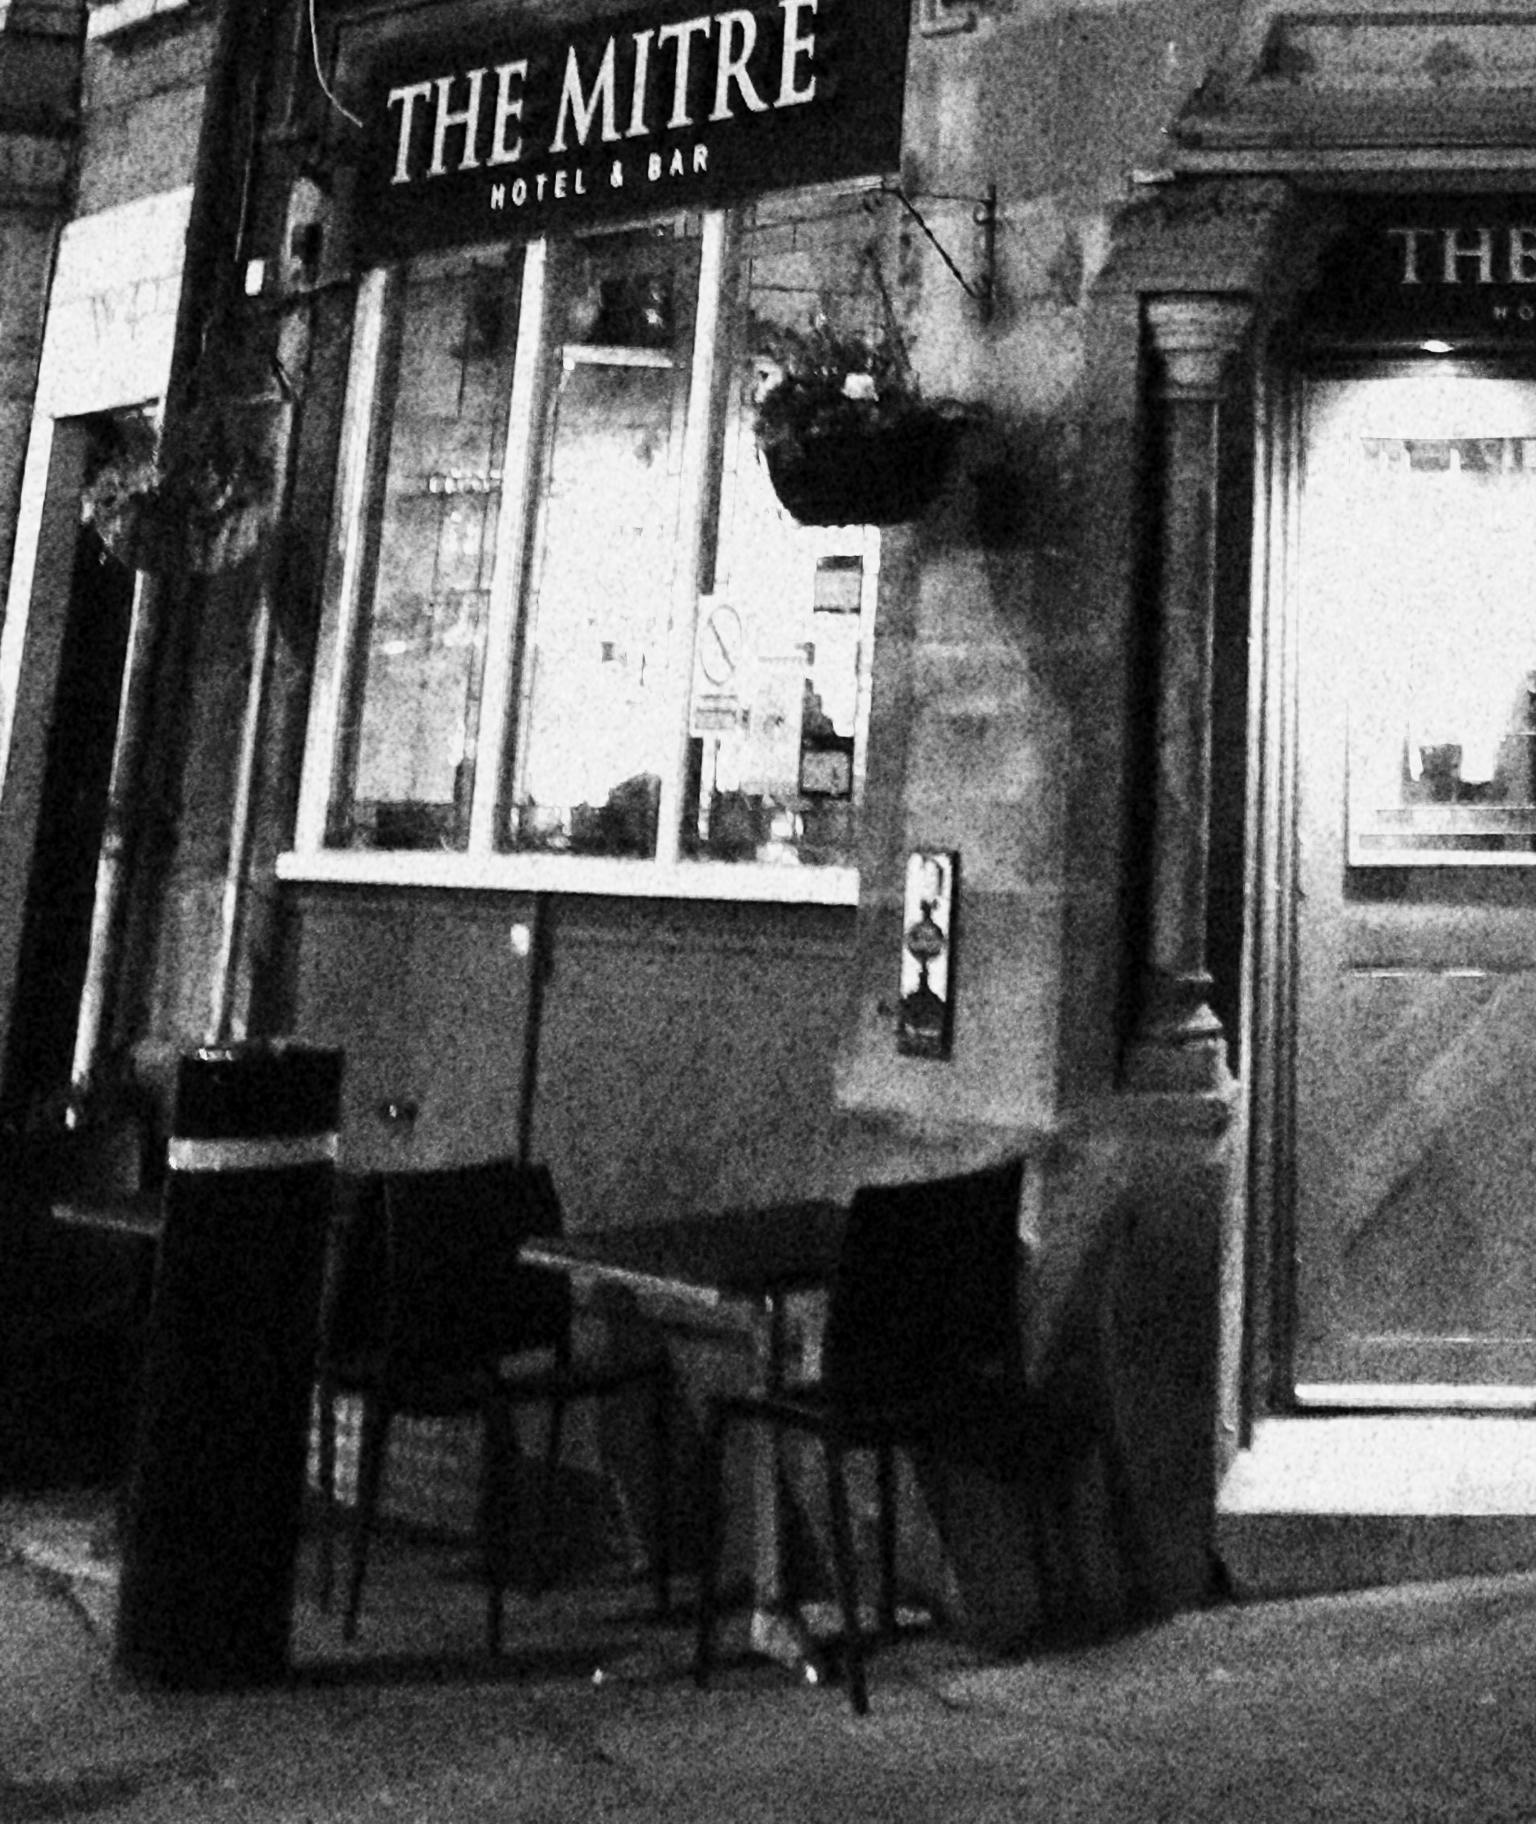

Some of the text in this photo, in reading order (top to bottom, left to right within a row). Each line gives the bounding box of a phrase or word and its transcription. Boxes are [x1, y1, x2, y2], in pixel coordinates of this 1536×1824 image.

[387, 60, 528, 185] THE
[490, 143, 708, 210] HOTEL & BAR
